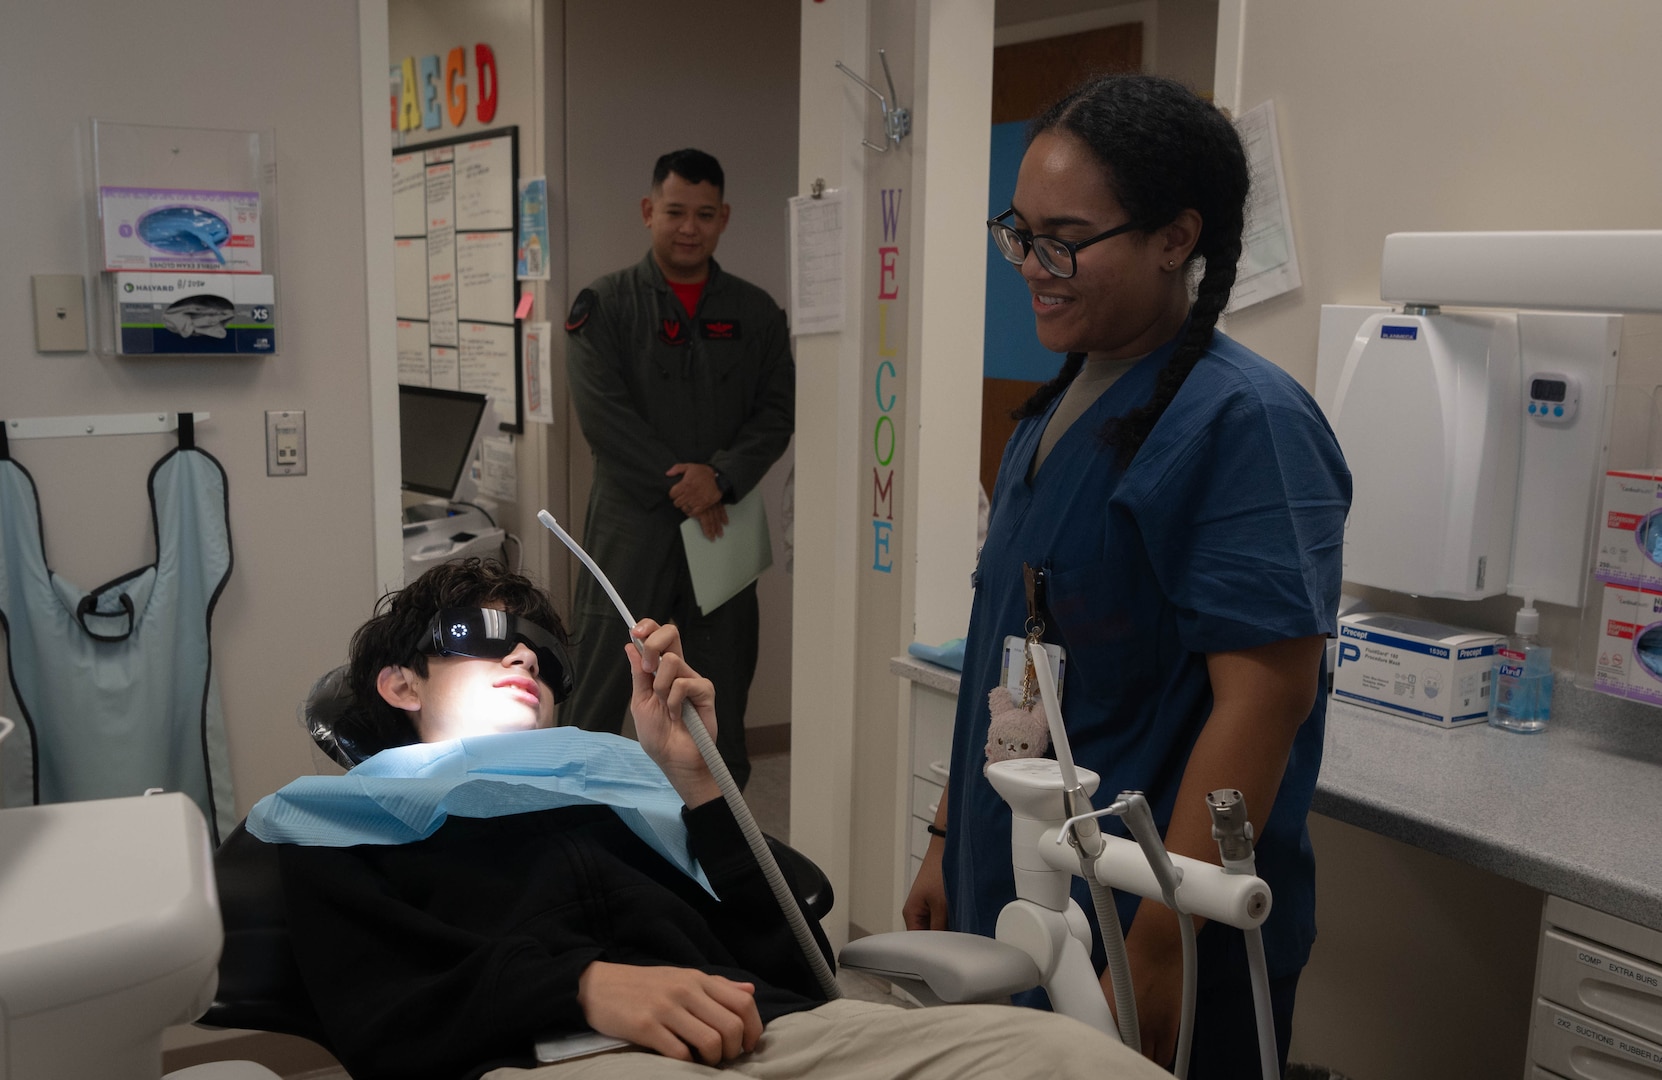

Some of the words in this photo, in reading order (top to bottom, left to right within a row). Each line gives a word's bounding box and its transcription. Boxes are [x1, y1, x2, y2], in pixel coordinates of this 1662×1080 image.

[399, 43, 498, 131] AEGD
[136, 284, 175, 292] HALYARD
[253, 309, 268, 319] XS
[872, 189, 902, 573] WELCOME
[1342, 627, 1368, 640] Precept
[1338, 641, 1361, 668] P
[1364, 654, 1388, 664] Procedure
[1459, 648, 1483, 659] Precept
[1502, 665, 1522, 677] Purell
[1579, 953, 1602, 966] COMP
[1609, 963, 1635, 979] EXTRA
[1636, 969, 1658, 987] BURS
[1557, 1018, 1572, 1029] 2X2
[1575, 1026, 1614, 1046] SUCTIONS
[1619, 1042, 1651, 1059] RUBBER
